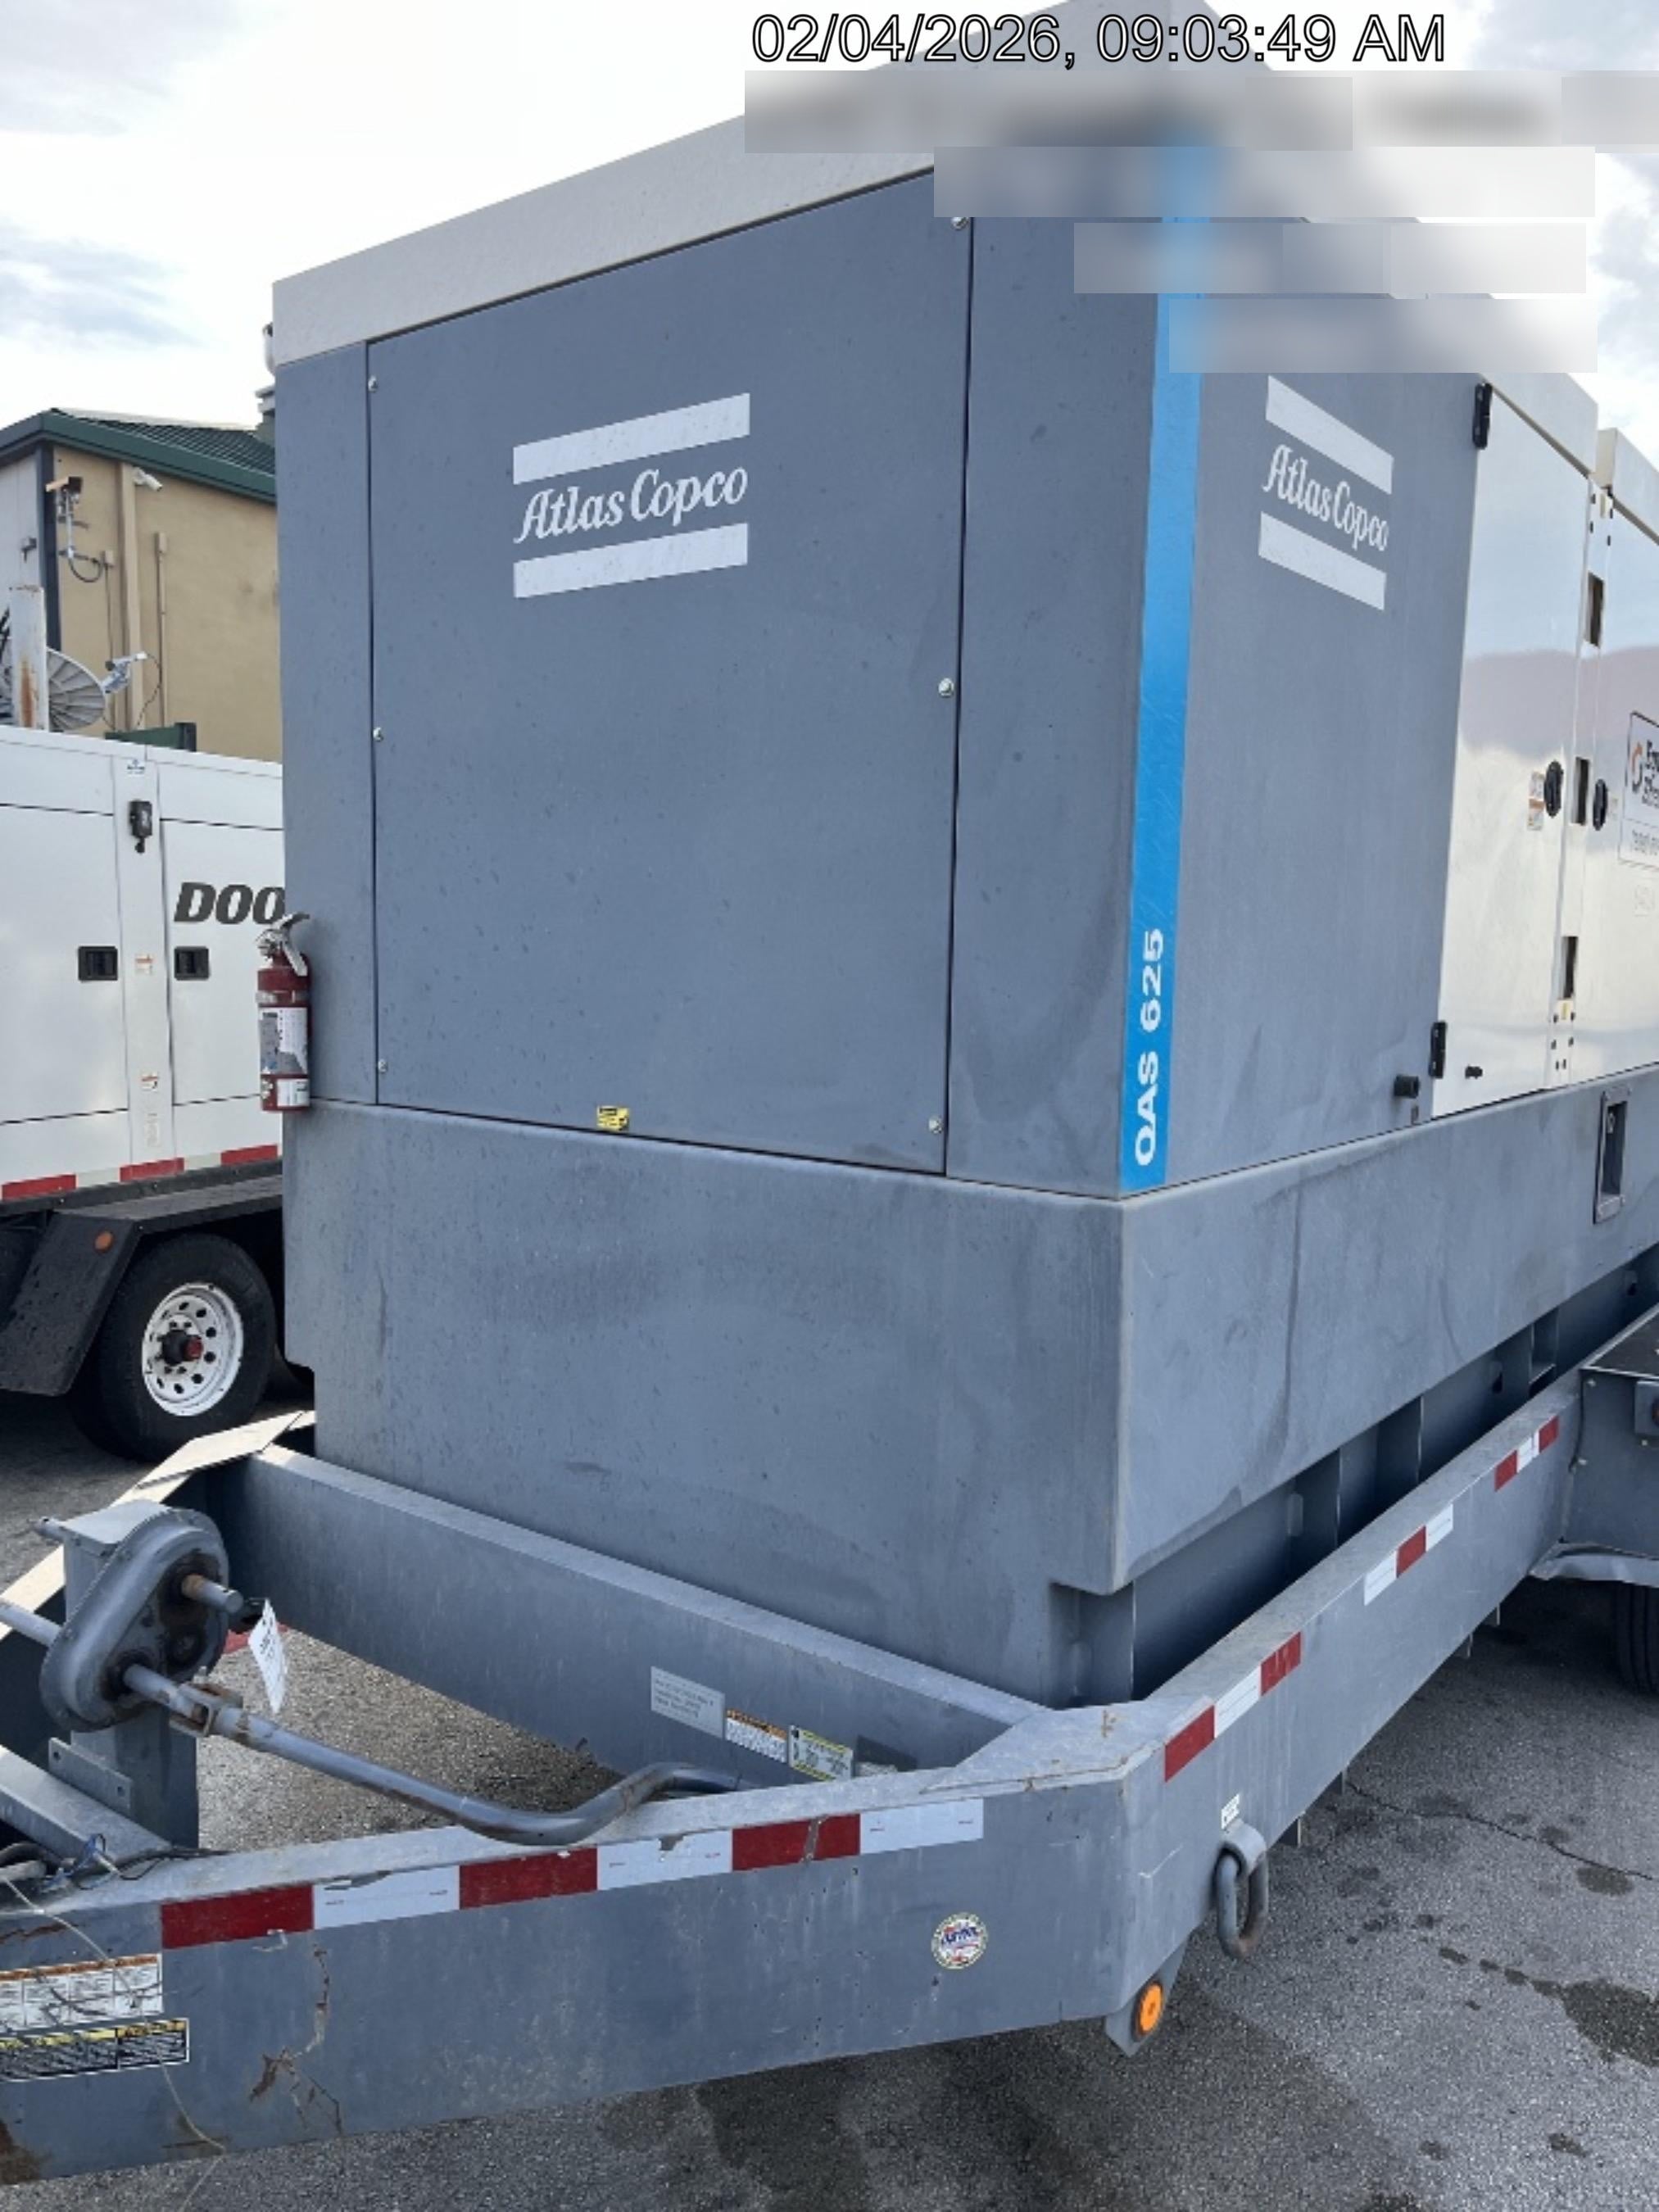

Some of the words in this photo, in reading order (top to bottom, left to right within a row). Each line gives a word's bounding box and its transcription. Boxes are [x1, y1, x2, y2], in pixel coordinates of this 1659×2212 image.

[514, 486, 625, 544] Atlas
[630, 466, 748, 527] Copco
[1262, 444, 1331, 523] Atlas
[1333, 480, 1389, 551] Copco
[1140, 928, 1164, 1032] 625
[1135, 1051, 1159, 1166] QAS
